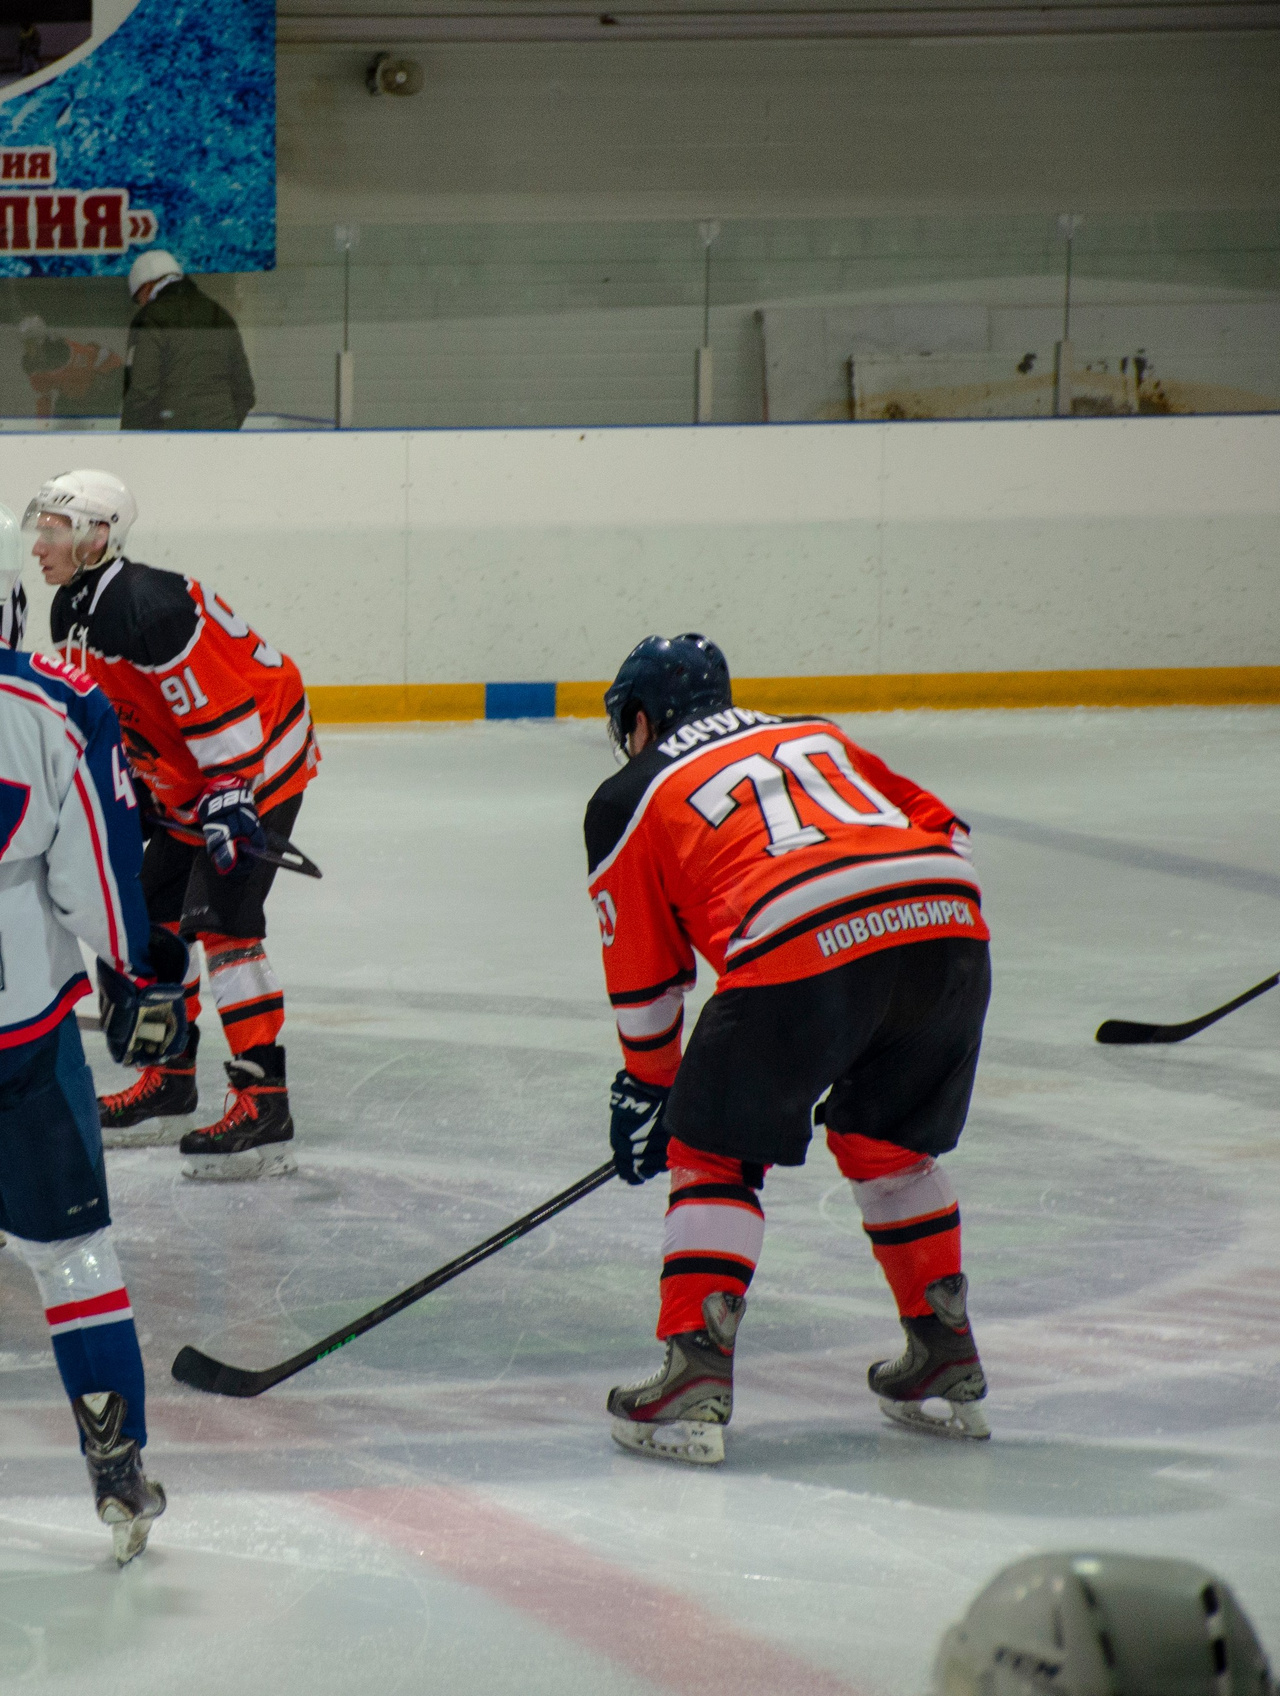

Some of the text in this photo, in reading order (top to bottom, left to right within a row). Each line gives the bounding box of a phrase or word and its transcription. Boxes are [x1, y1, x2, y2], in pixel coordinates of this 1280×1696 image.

[160, 665, 209, 716] 91
[111, 743, 138, 810] 4
[207, 788, 256, 817] BAU
[686, 733, 912, 857] 70
[817, 900, 975, 957] НОВОСИБИРСК
